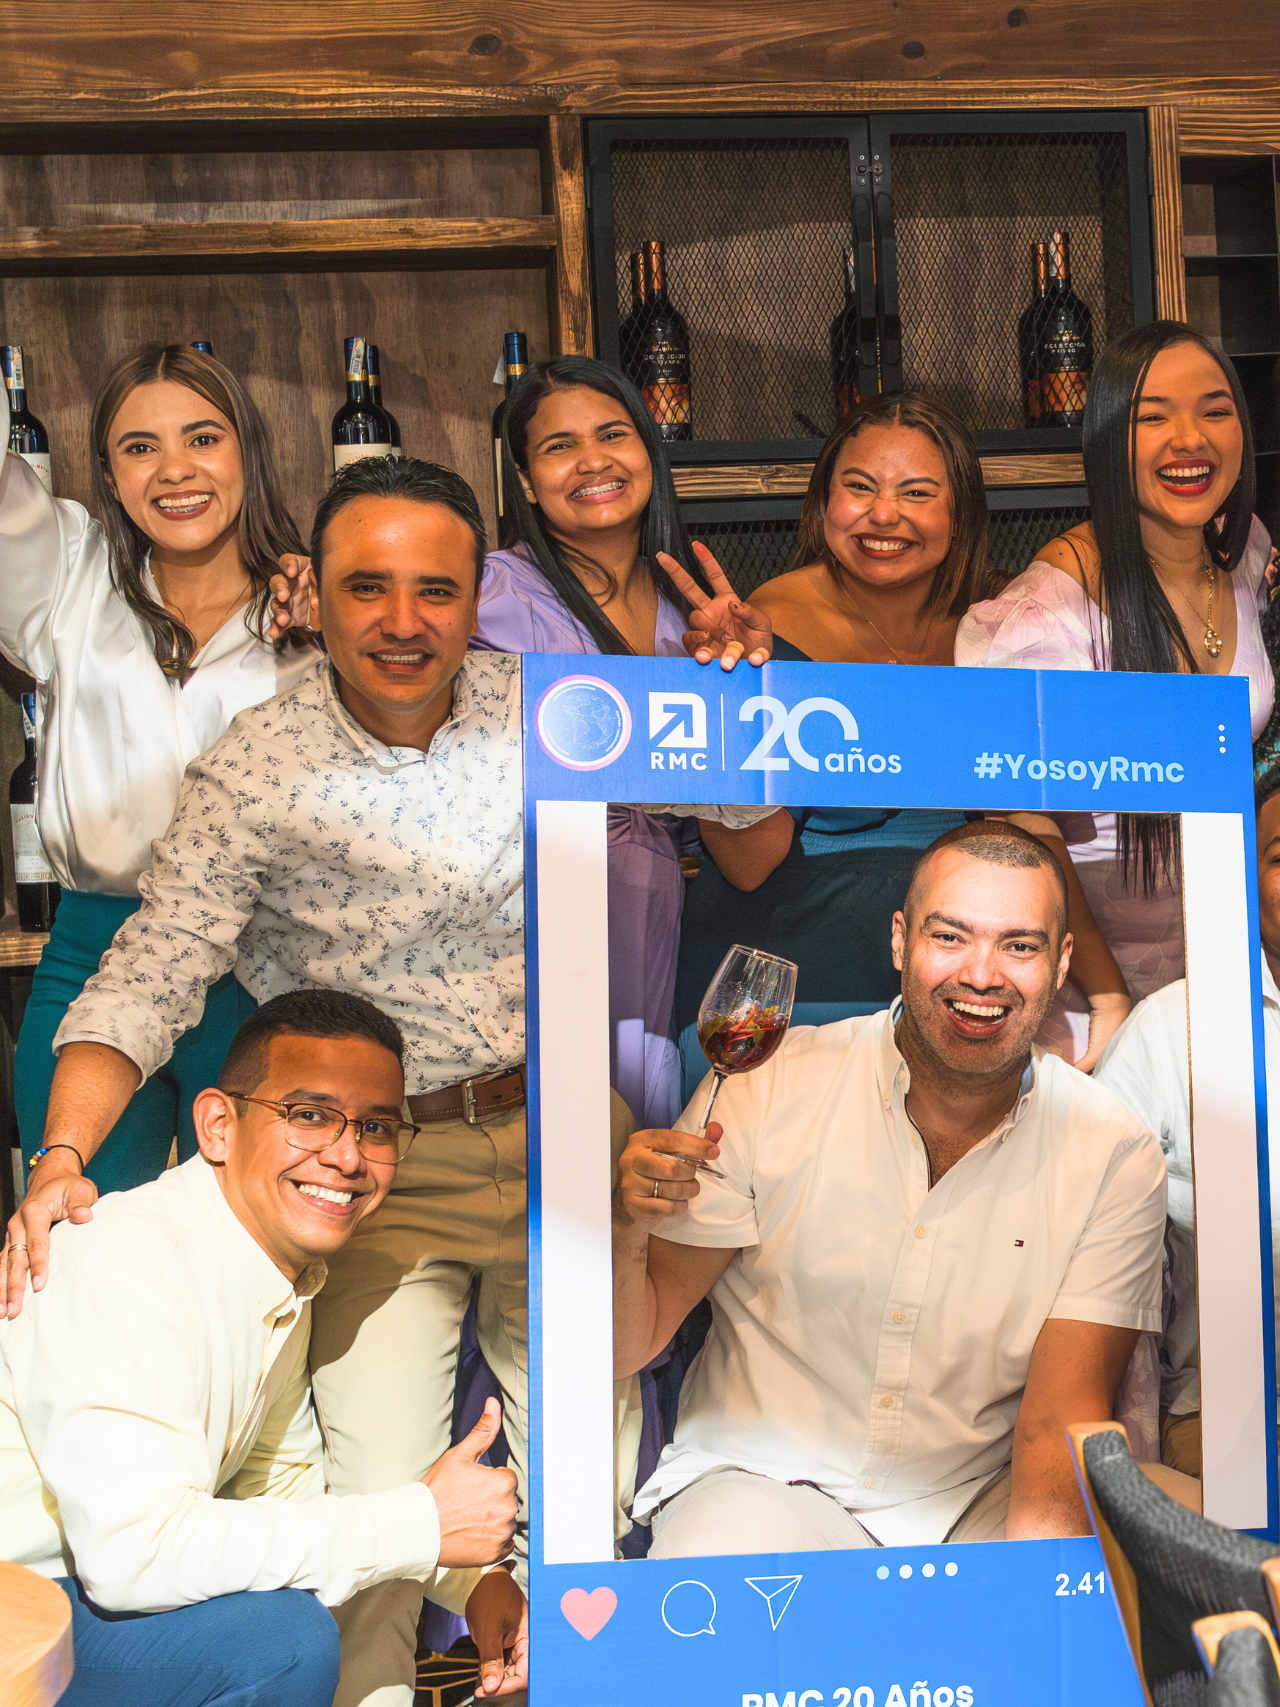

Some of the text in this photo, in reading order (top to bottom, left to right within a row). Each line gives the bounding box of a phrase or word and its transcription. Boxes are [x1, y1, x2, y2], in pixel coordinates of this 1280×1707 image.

[738, 695, 902, 774] 20 años
[650, 752, 708, 771] RMC
[973, 752, 1185, 790] #YosoyRmc
[1055, 1571, 1105, 1596] 2.41
[832, 1686, 875, 1707] 20
[884, 1680, 974, 1707] Años
